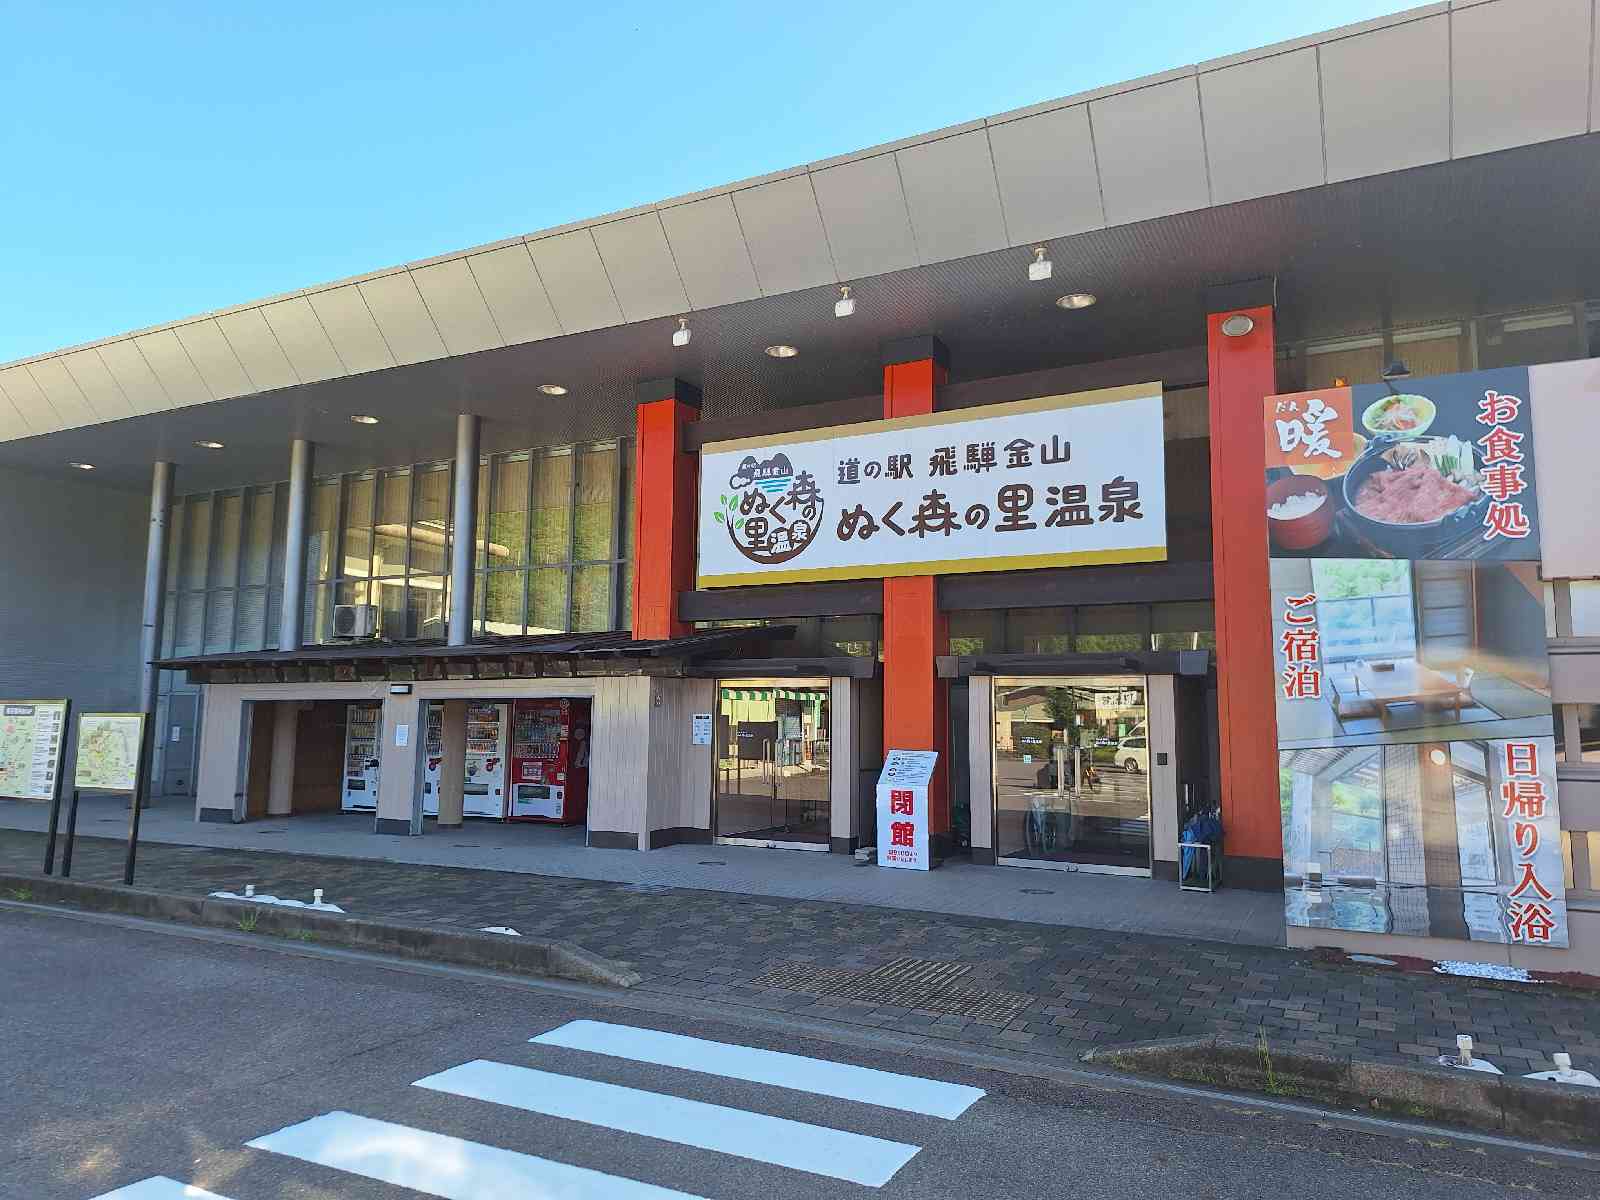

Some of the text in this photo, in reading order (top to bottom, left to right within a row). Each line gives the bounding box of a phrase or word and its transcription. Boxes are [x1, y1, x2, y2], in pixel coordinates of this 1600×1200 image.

[837, 434, 1072, 485] 道の駅 飛騨金山
[1275, 399, 1342, 458] 暖
[1476, 390, 1531, 540] お食事処
[836, 475, 1144, 541] ぬく森の里温泉
[1281, 592, 1321, 699] ご宿泊
[890, 790, 915, 848] 閉館
[1502, 742, 1557, 943] 日帰り入浴
